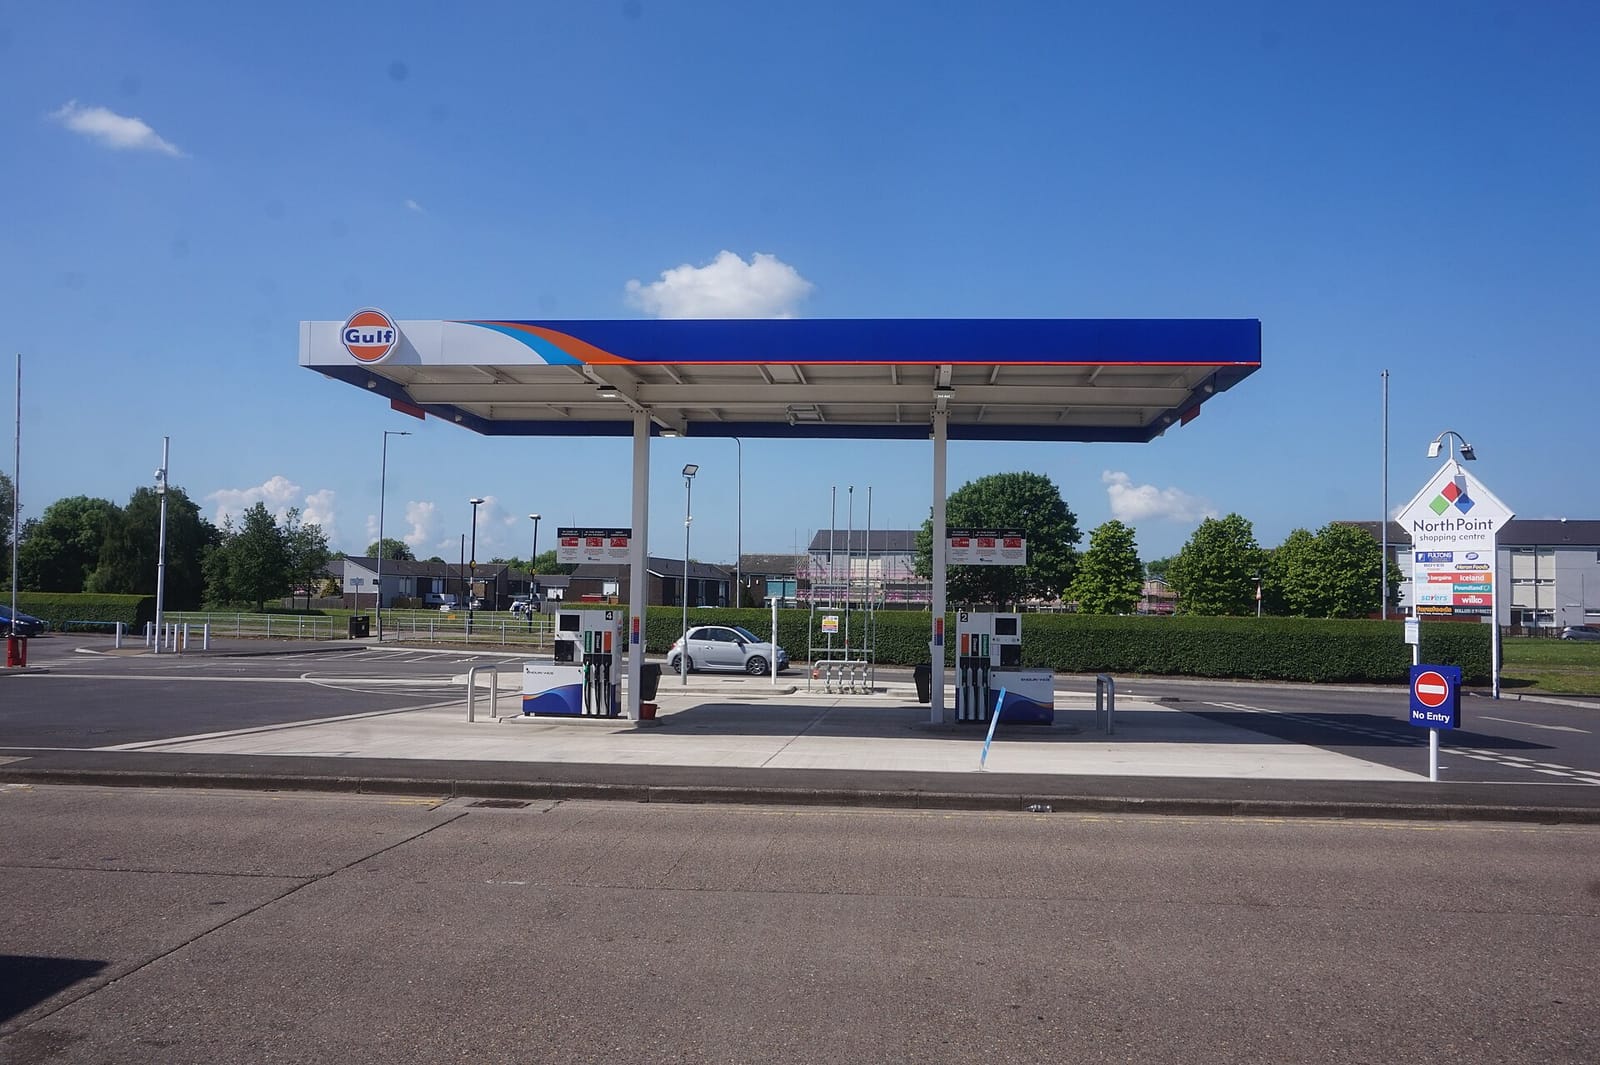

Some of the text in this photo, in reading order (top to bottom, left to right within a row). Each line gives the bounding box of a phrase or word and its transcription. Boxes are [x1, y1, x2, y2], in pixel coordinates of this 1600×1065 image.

[345, 329, 393, 343] Gulf
[1419, 533, 1486, 543] shopping centre
[1461, 595, 1484, 604] wilko
[606, 611, 612, 620] 4
[961, 613, 968, 622] 2
[1412, 710, 1450, 724] No Entry
